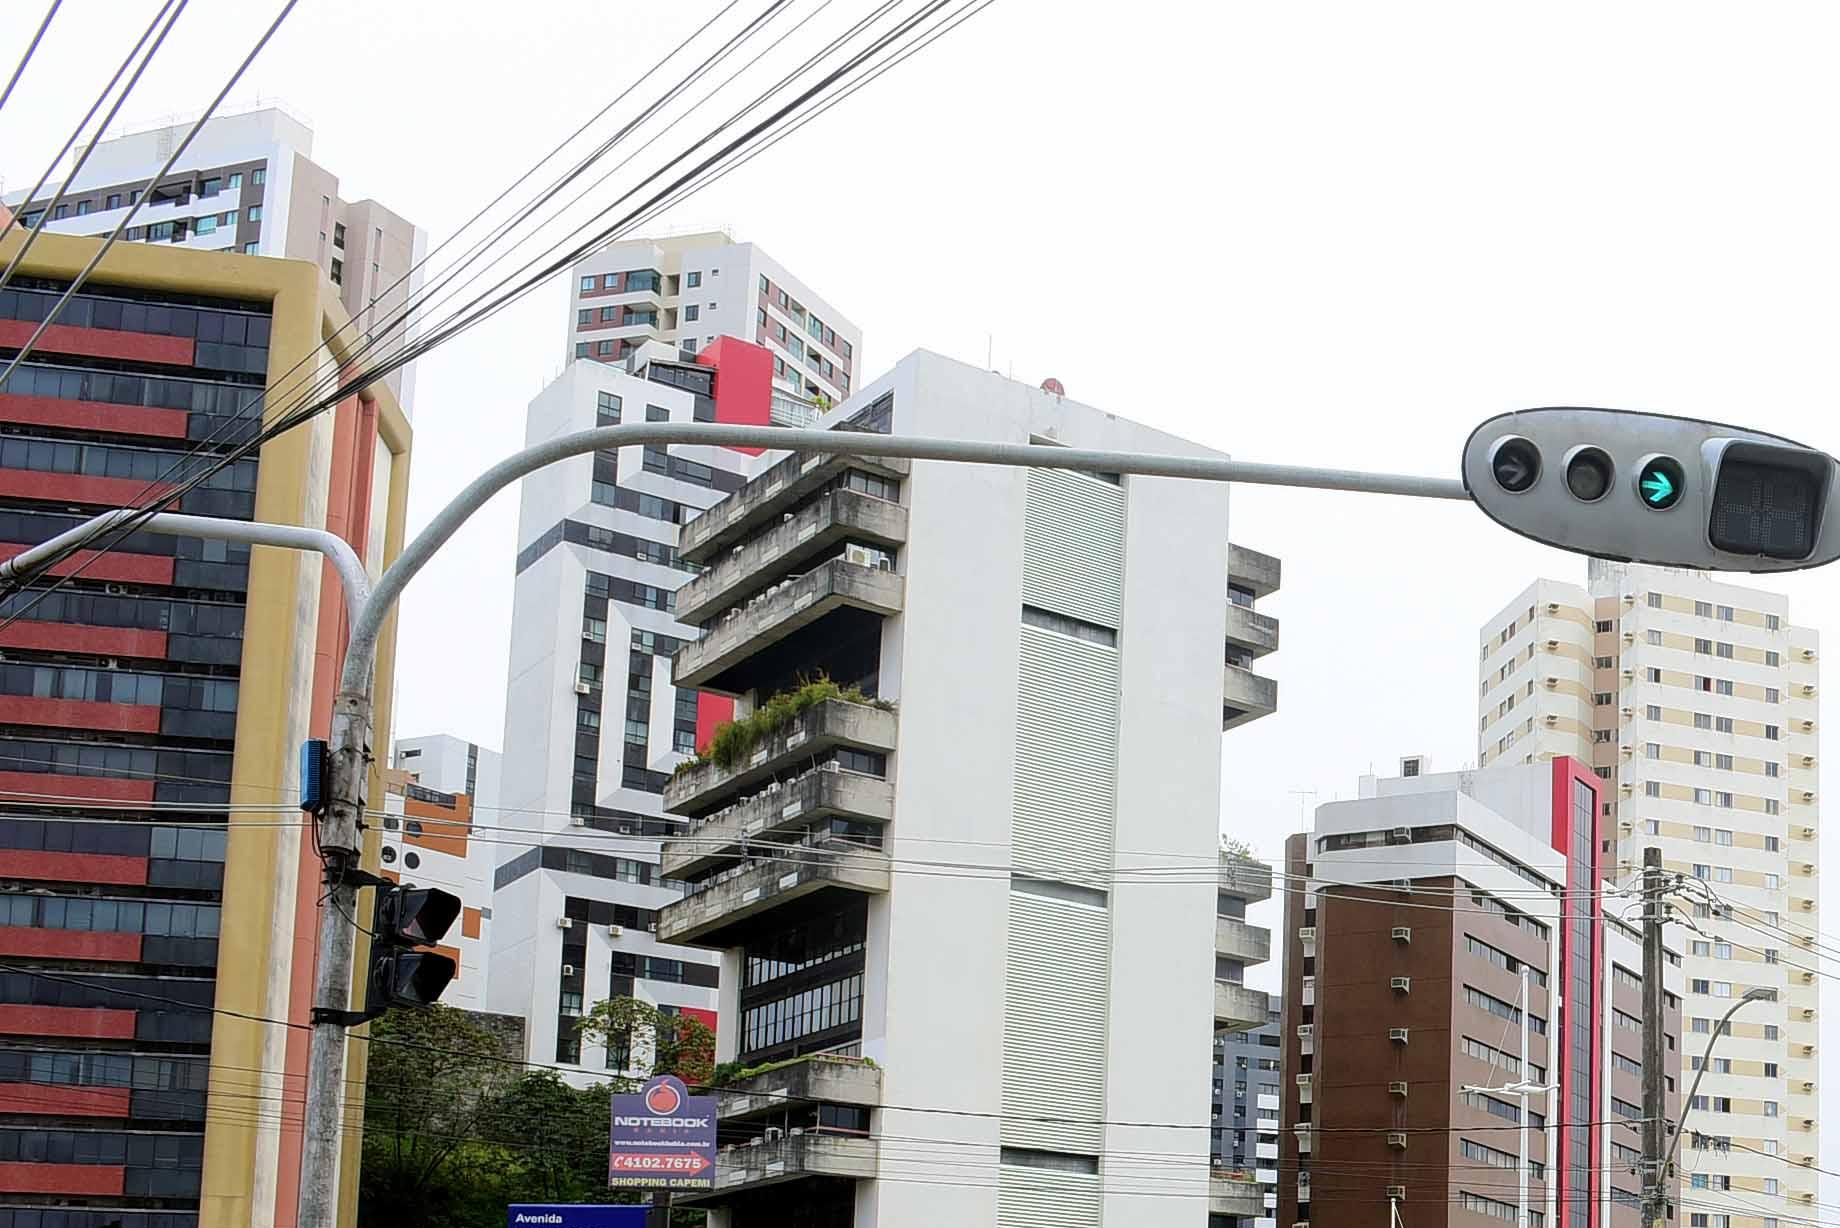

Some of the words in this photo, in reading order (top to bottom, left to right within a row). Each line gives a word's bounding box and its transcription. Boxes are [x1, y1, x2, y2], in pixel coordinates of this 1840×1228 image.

[614, 1117, 709, 1128] NOTEBOOK
[623, 1156, 702, 1169] 4102.7675
[611, 1177, 667, 1187] SHOPPING
[669, 1178, 711, 1187] CAPEMI
[515, 1213, 563, 1224] Avenida
